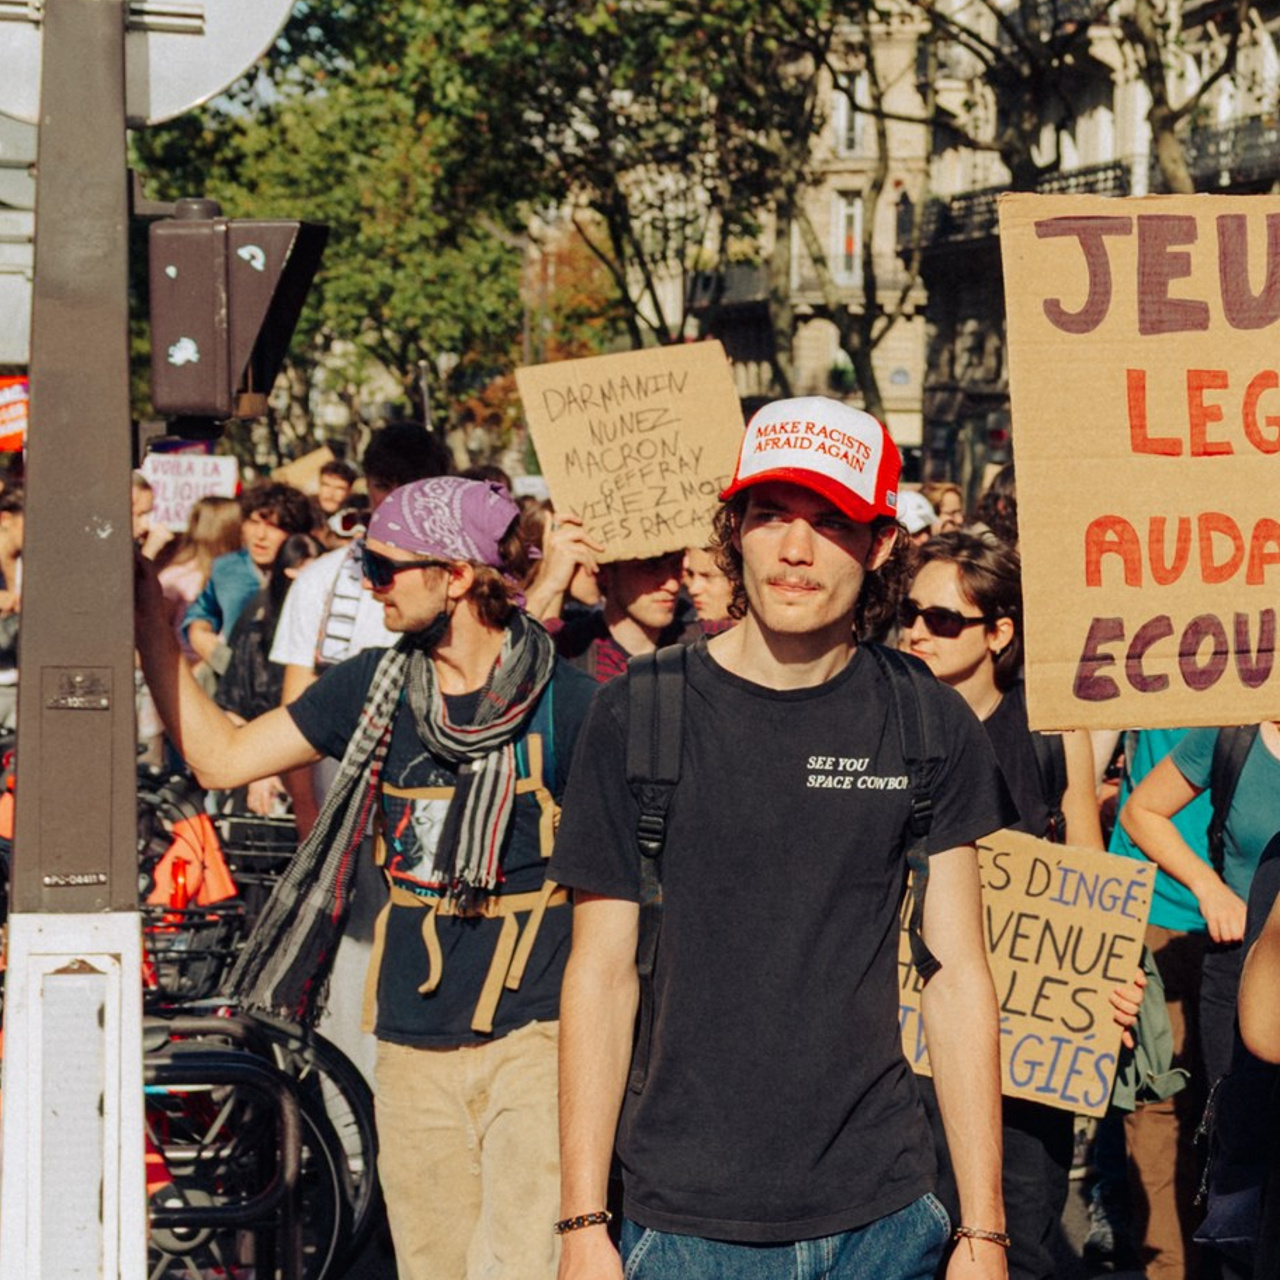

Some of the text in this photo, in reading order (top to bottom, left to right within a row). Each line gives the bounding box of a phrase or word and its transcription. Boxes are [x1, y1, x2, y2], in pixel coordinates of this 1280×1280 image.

[541, 371, 688, 423] DARMANIN
[588, 407, 683, 446] NUNEZ
[756, 420, 873, 461] MAKE RACISTS
[564, 431, 680, 479] MACRON
[754, 436, 866, 475] AFRAID AGAIN
[806, 755, 870, 772] SEE YOU
[806, 774, 854, 790] SPACE
[1001, 969, 1099, 1034] LES
